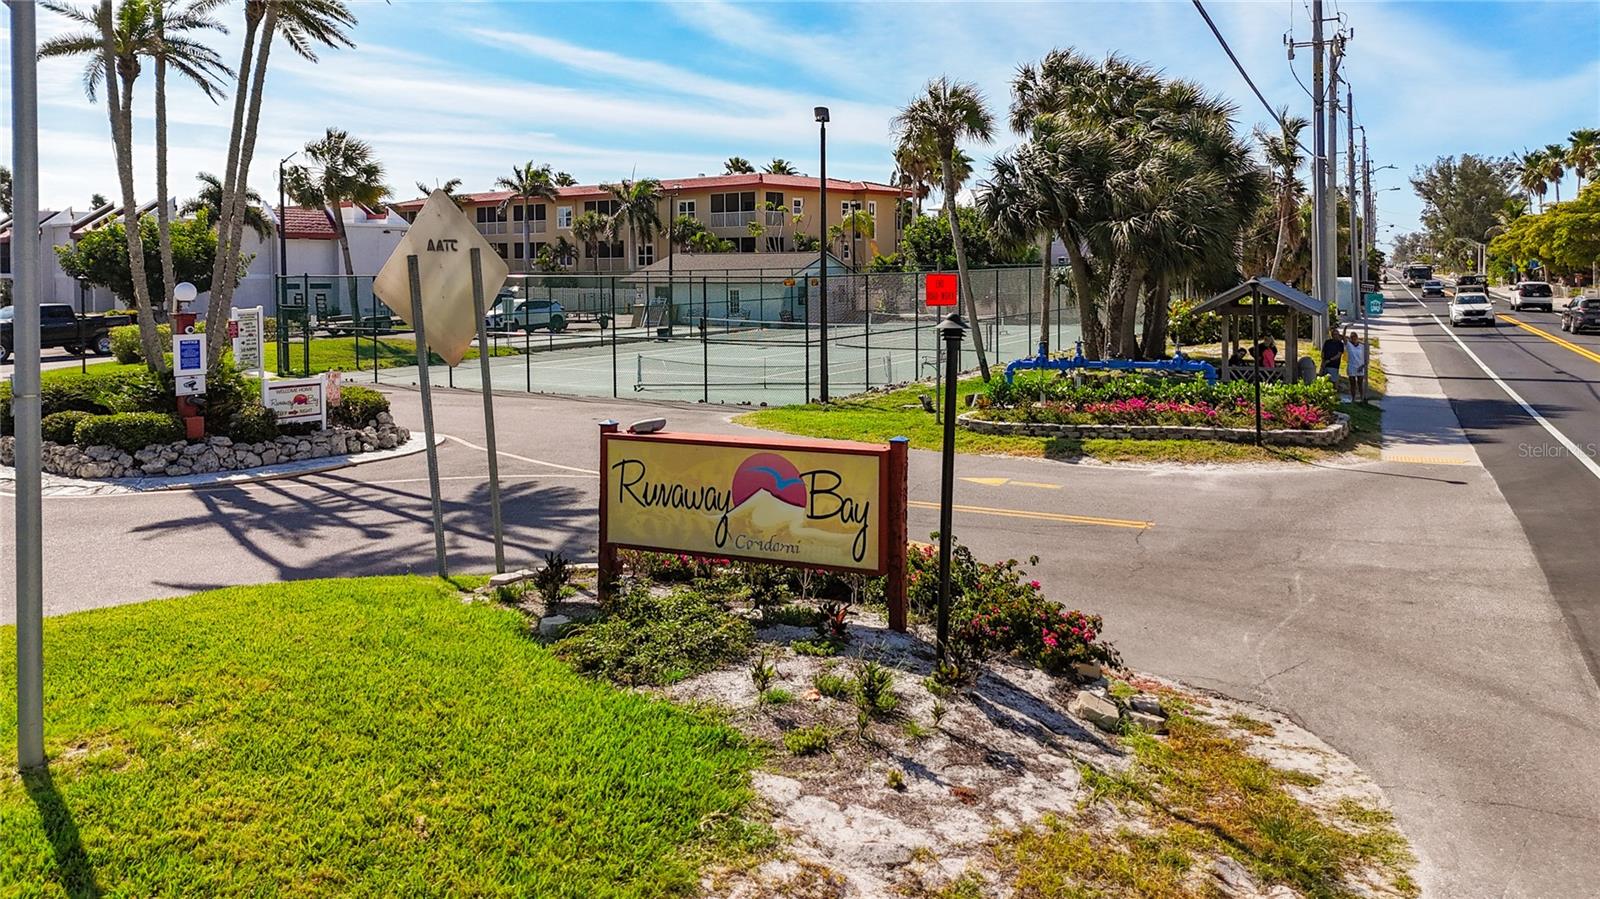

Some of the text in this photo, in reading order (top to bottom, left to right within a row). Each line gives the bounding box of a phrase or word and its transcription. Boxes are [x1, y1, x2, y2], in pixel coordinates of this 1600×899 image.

[426, 238, 458, 252] AATC
[611, 458, 870, 562] Runaway Bay
